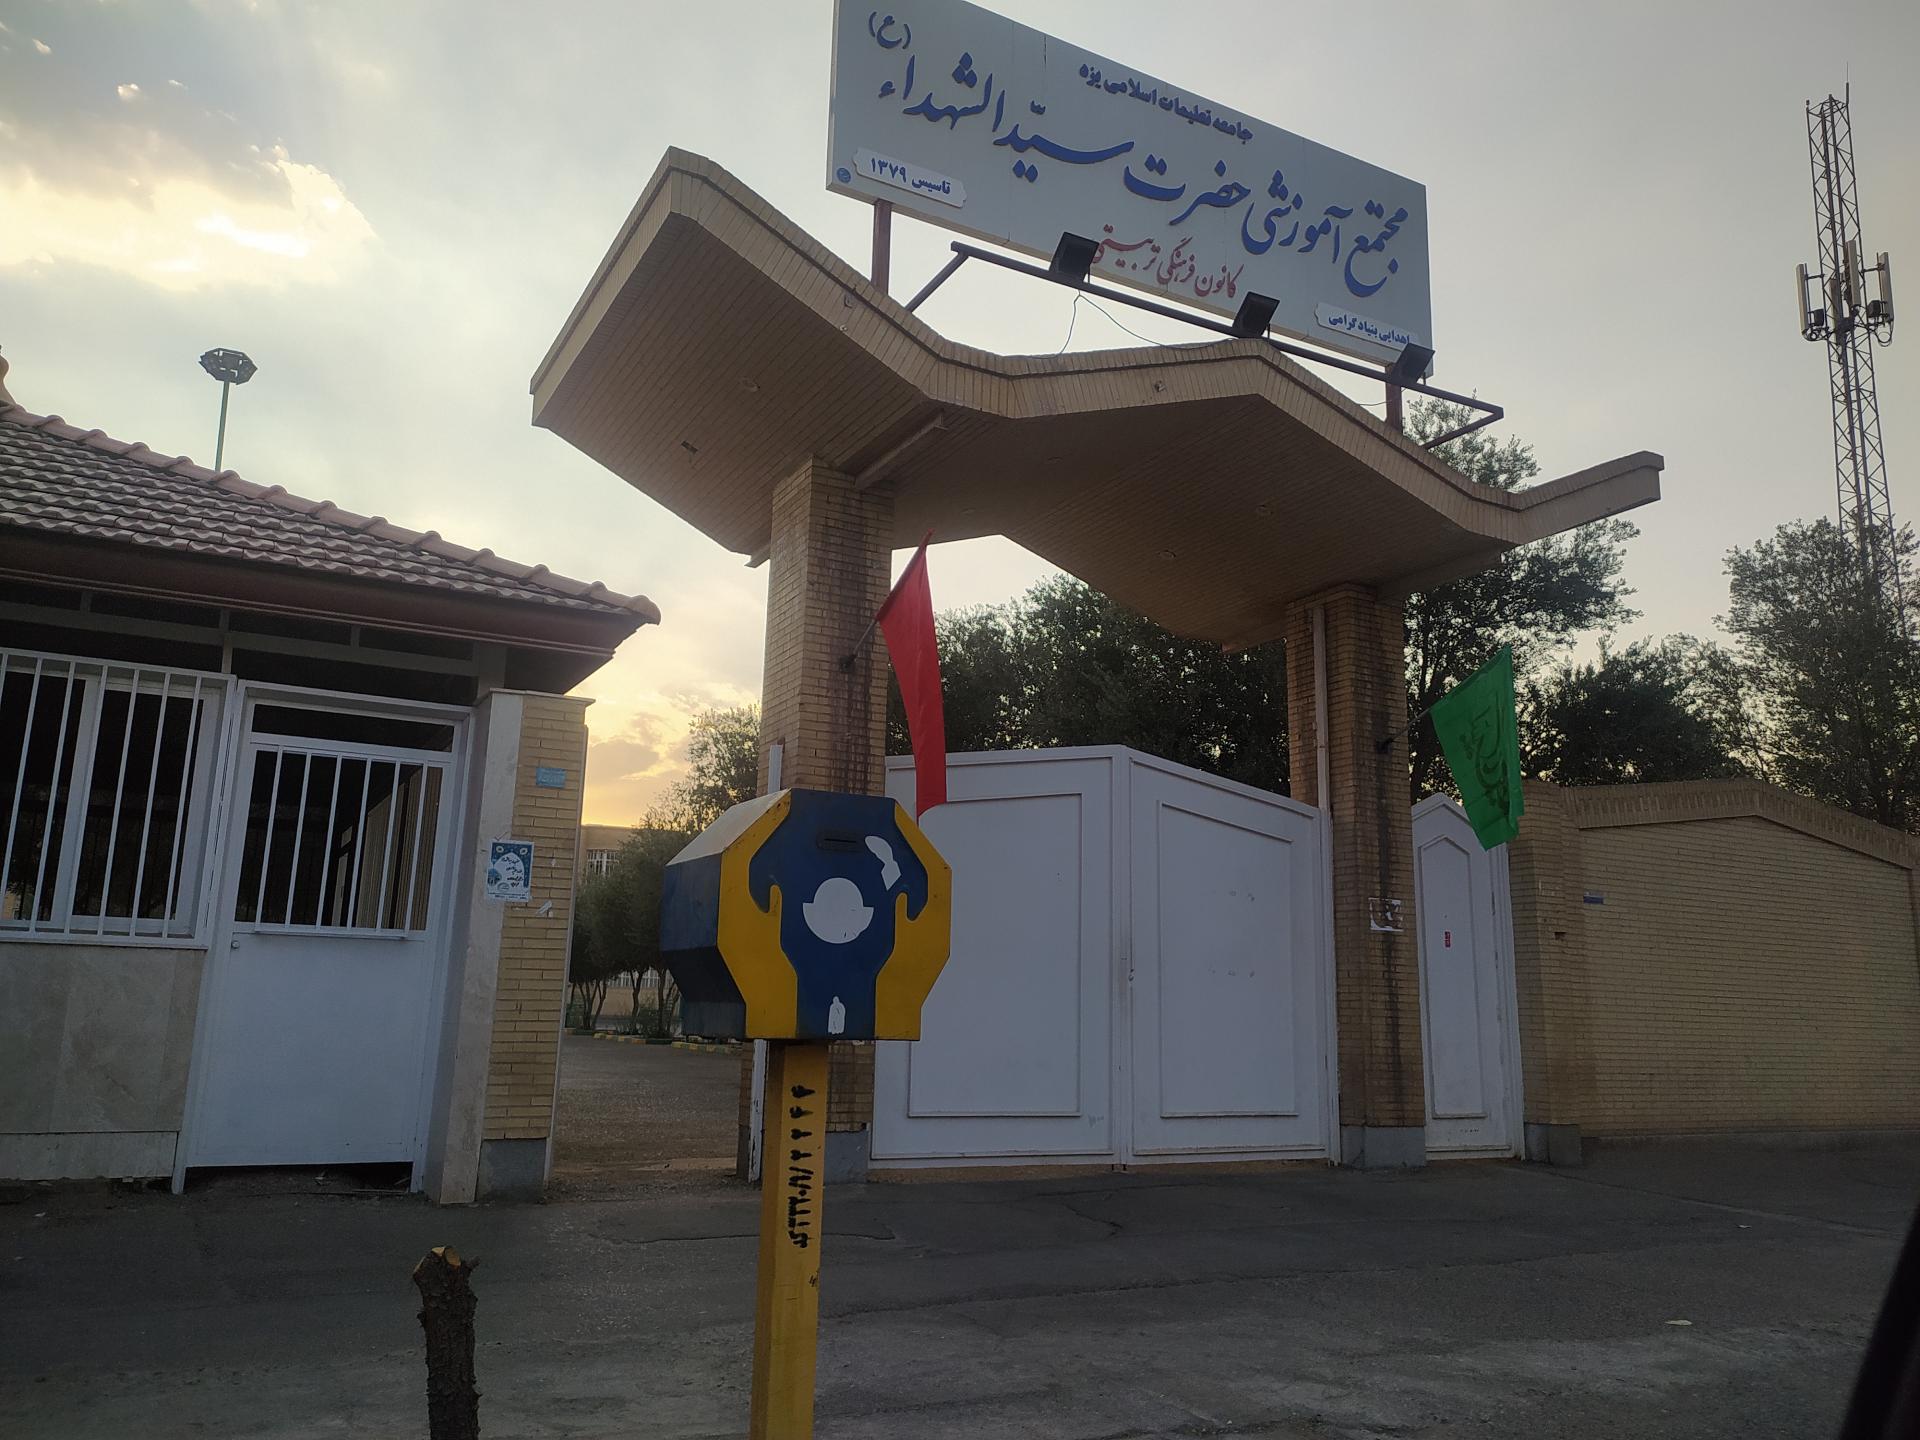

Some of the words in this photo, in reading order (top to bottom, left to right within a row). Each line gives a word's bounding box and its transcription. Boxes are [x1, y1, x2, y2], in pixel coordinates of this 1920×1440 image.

[1103, 78, 1158, 105] اسلامی
[1158, 97, 1212, 126] تعلیمات
[1212, 118, 1253, 145] جامعه
[871, 157, 907, 183] ۱۳۷۹
[911, 178, 951, 195] تاسیس
[1123, 154, 1251, 226] حضرت
[1241, 169, 1354, 265] آموزشی
[1156, 236, 1195, 285] فرهنگی
[1344, 199, 1409, 298] مجتمع
[1194, 264, 1245, 299] کانون
